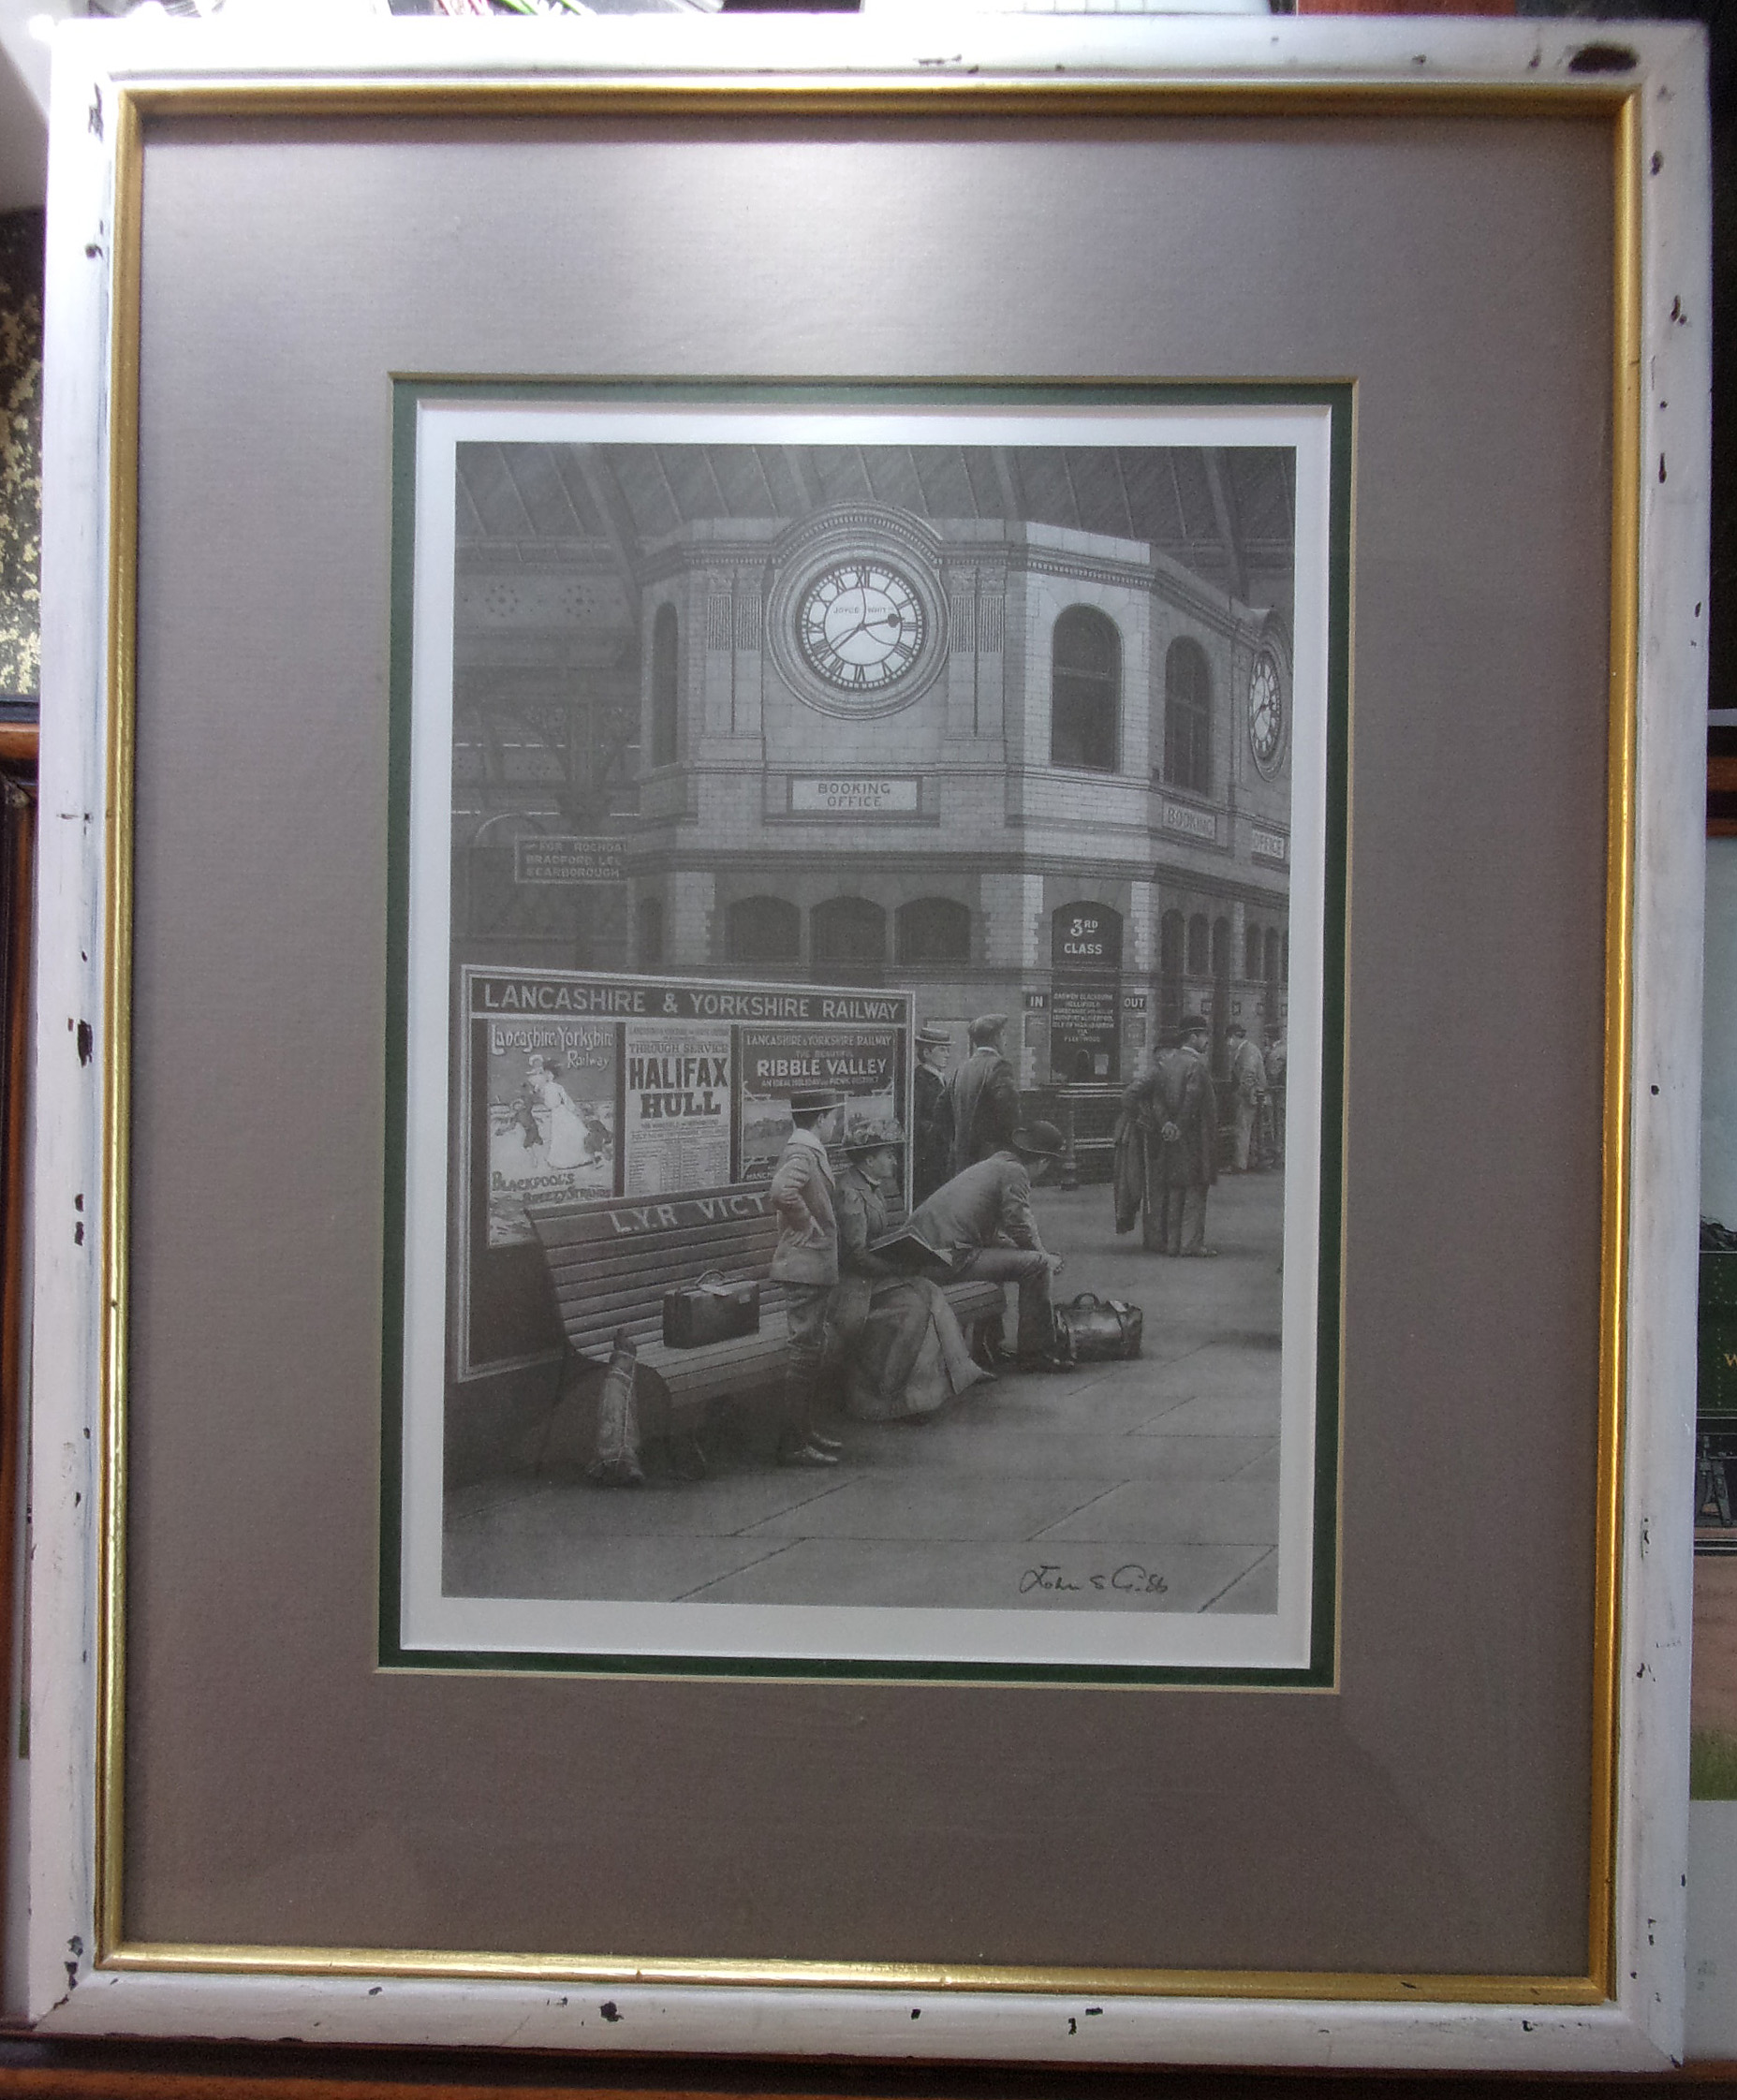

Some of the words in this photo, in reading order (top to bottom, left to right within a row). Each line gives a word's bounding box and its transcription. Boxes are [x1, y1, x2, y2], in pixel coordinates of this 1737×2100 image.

[817, 783, 891, 794] BOOKING
[827, 796, 882, 807] OFFICE
[526, 867, 619, 878] SCARBOROUGH
[1070, 918, 1098, 936] 3RD
[1064, 943, 1103, 955] CLASS
[484, 983, 646, 1013] LANCASHIRE
[662, 992, 678, 1013] &
[690, 992, 809, 1018] YORKSHIRE
[822, 999, 898, 1020] RAILWAY
[1030, 995, 1043, 1007] IN
[1124, 997, 1144, 1008] OUT
[492, 1024, 555, 1055] Lancashire
[557, 1025, 614, 1052] Yorkshire
[746, 1035, 802, 1046] LANCASHIRE
[808, 1035, 854, 1046] YORKSHIRE
[857, 1035, 892, 1047] RAILWAY
[628, 1043, 680, 1054] THROUGH
[683, 1042, 729, 1054] SERVICE
[567, 1050, 610, 1072] Railway
[629, 1057, 729, 1090] HALIFAX
[757, 1059, 821, 1077] RIBBLE
[826, 1058, 887, 1076] VALLEY
[640, 1091, 721, 1119] HULL
